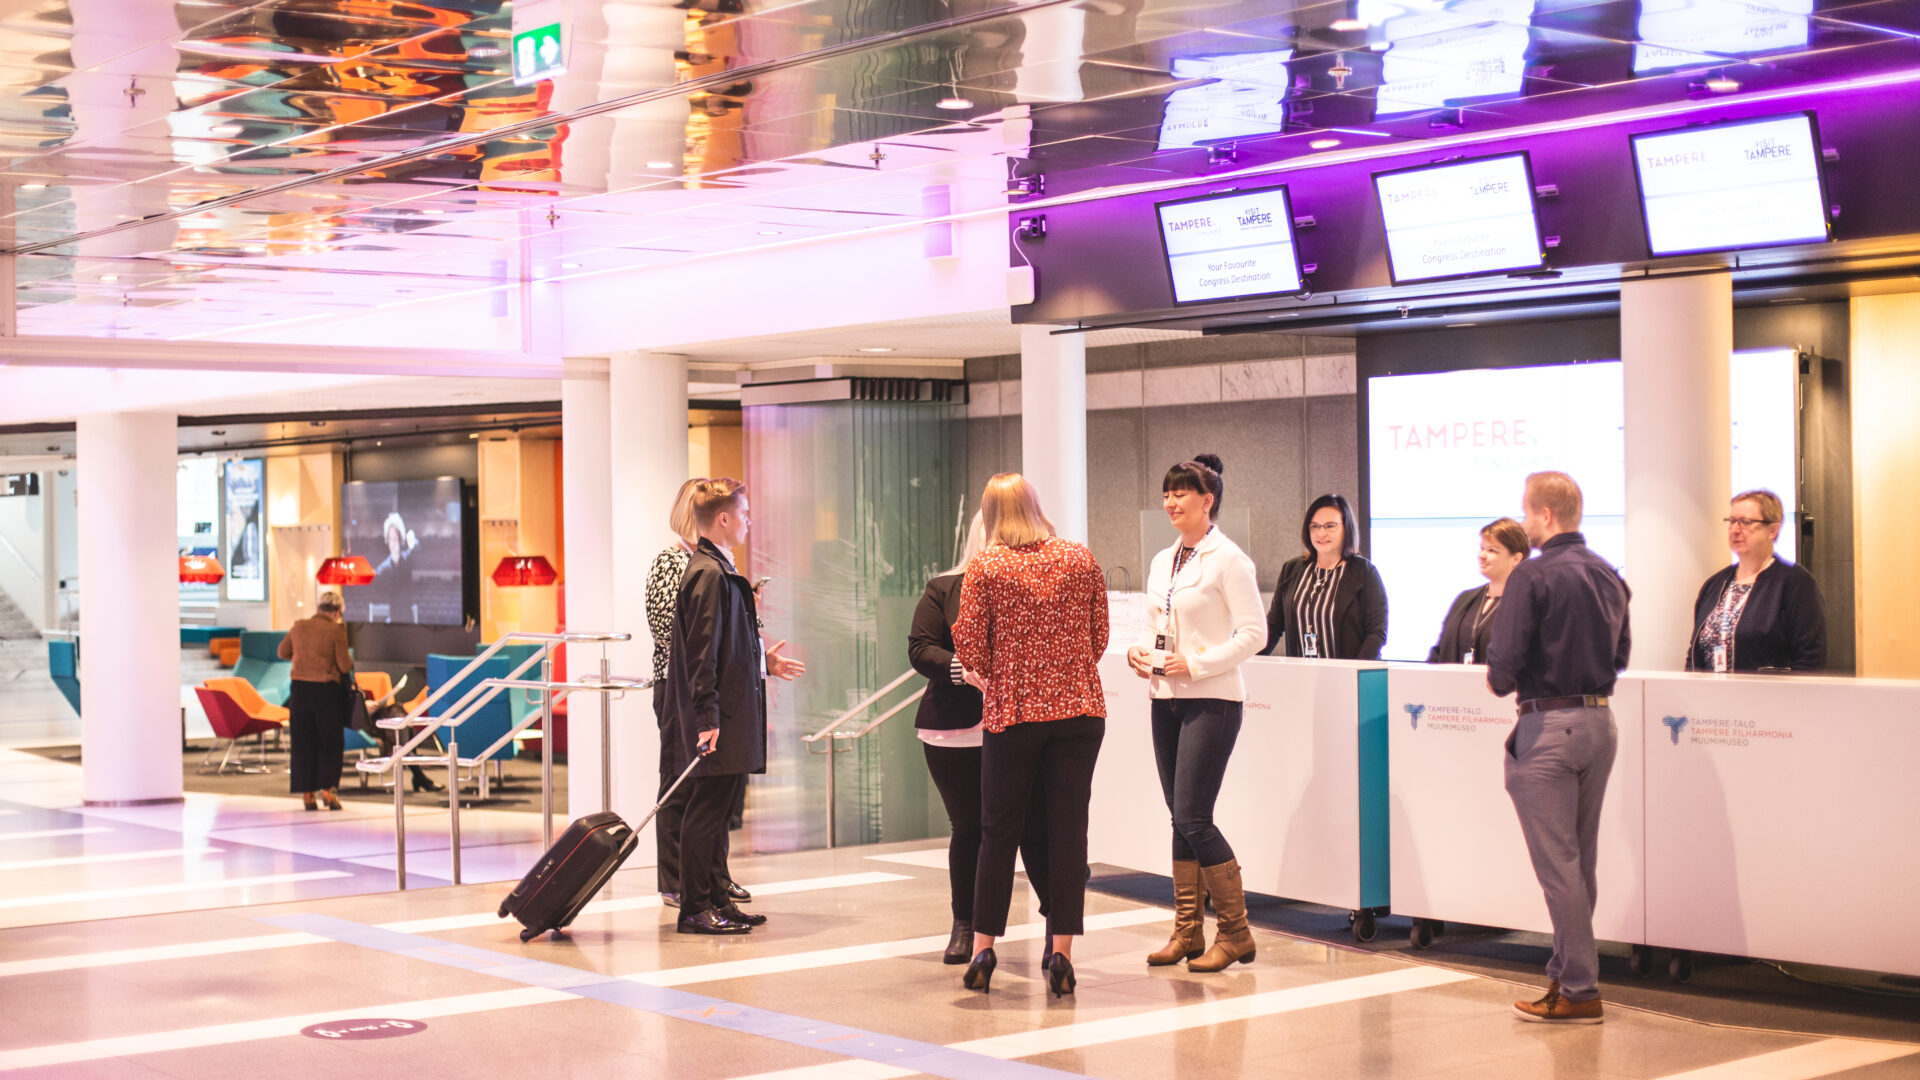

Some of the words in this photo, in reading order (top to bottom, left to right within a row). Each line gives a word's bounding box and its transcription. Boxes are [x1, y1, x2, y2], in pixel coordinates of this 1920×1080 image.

[1755, 137, 1775, 147] VISIT
[1744, 144, 1792, 160] TAMPERE
[1647, 150, 1708, 169] TAMPERE
[1469, 181, 1510, 196] TAMPERE
[1244, 207, 1260, 216] VISIT
[1237, 212, 1273, 227] TAMPERE
[1422, 252, 1458, 264] Congress
[1460, 247, 1506, 260] Destination
[1207, 263, 1223, 273] Your
[1224, 259, 1257, 271] Favourite
[1199, 276, 1230, 288] Congress
[1231, 272, 1271, 284] Destination
[1428, 705, 1481, 715] TAMPERE-TALO
[1428, 714, 1460, 723] TAMPERE
[1462, 715, 1513, 725] FILHARMONIA
[1691, 718, 1756, 728] TAMPERE-TALO
[1427, 723, 1477, 732] MUUMIMUSEO
[1691, 727, 1730, 737] TAMPERE
[1732, 729, 1793, 739] FILHARMONIA
[1691, 737, 1749, 747] MUUMIMUSEO
